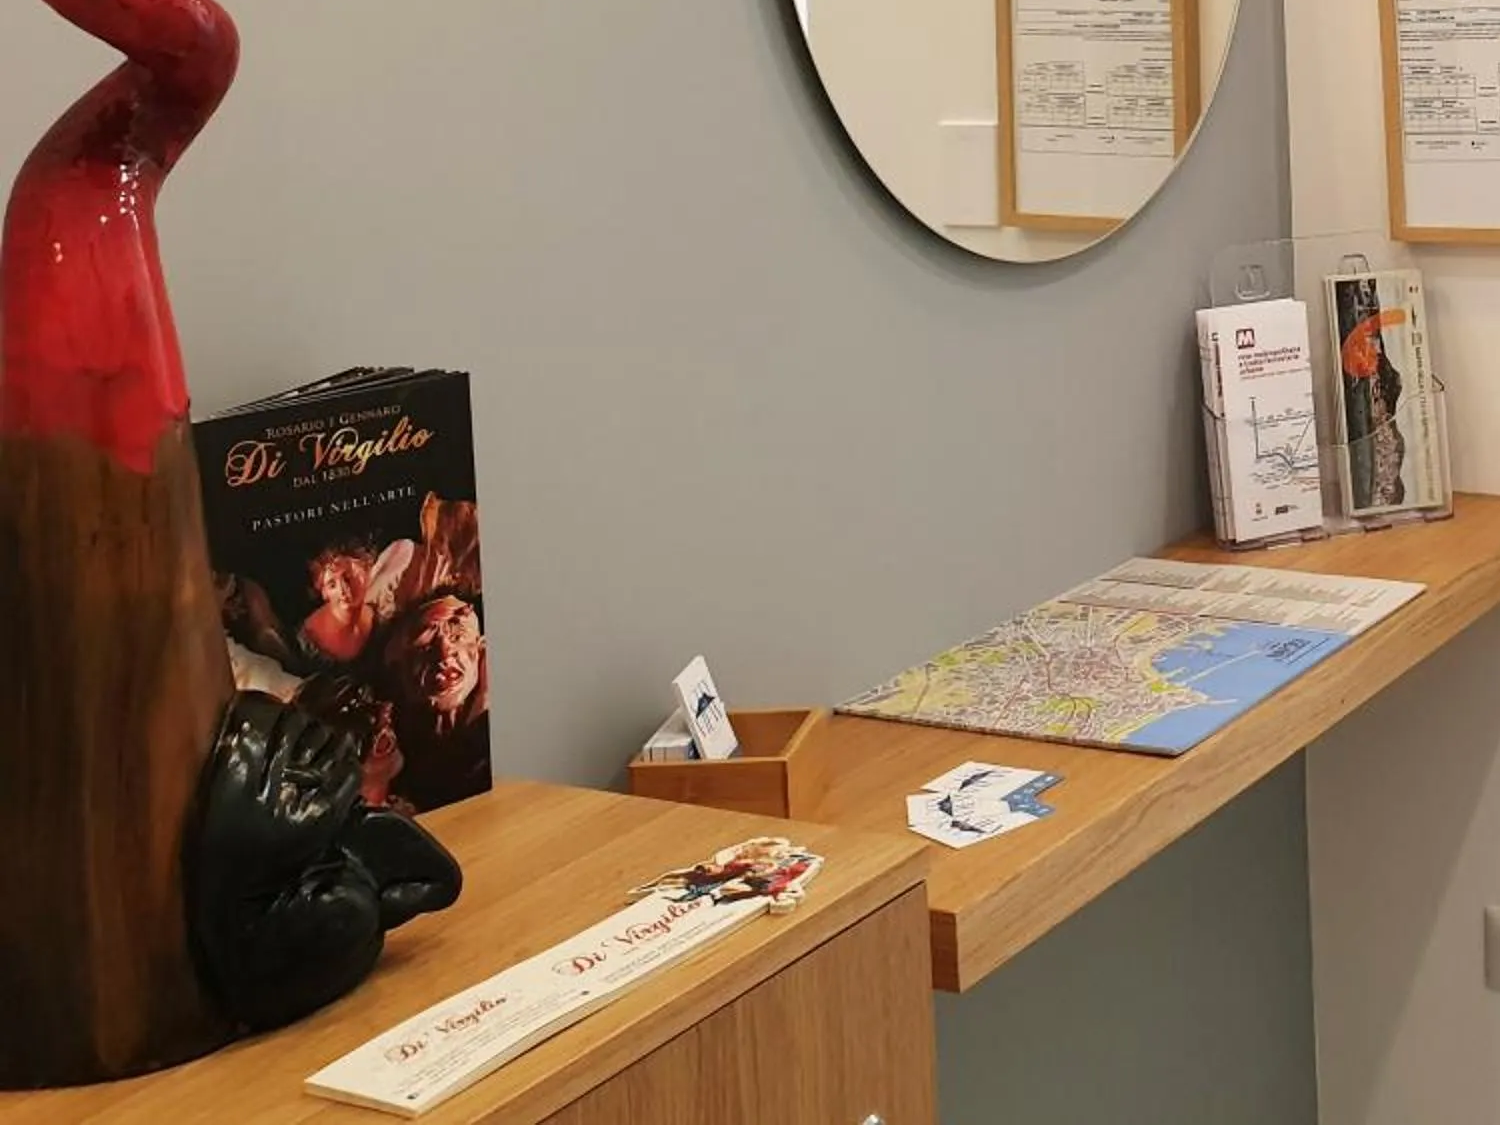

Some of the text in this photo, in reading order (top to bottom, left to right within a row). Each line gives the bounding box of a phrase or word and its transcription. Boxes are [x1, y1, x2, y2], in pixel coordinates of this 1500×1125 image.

[265, 420, 325, 440] ROSARIO
[339, 405, 402, 426] GENNARO
[225, 415, 434, 487] Di Virgilio
[292, 475, 317, 489] DAL
[252, 485, 417, 532] PASTORI NELL'ARTE
[552, 941, 608, 975] Di
[614, 899, 703, 945] Virgilio
[434, 996, 508, 1035] Virgilio
